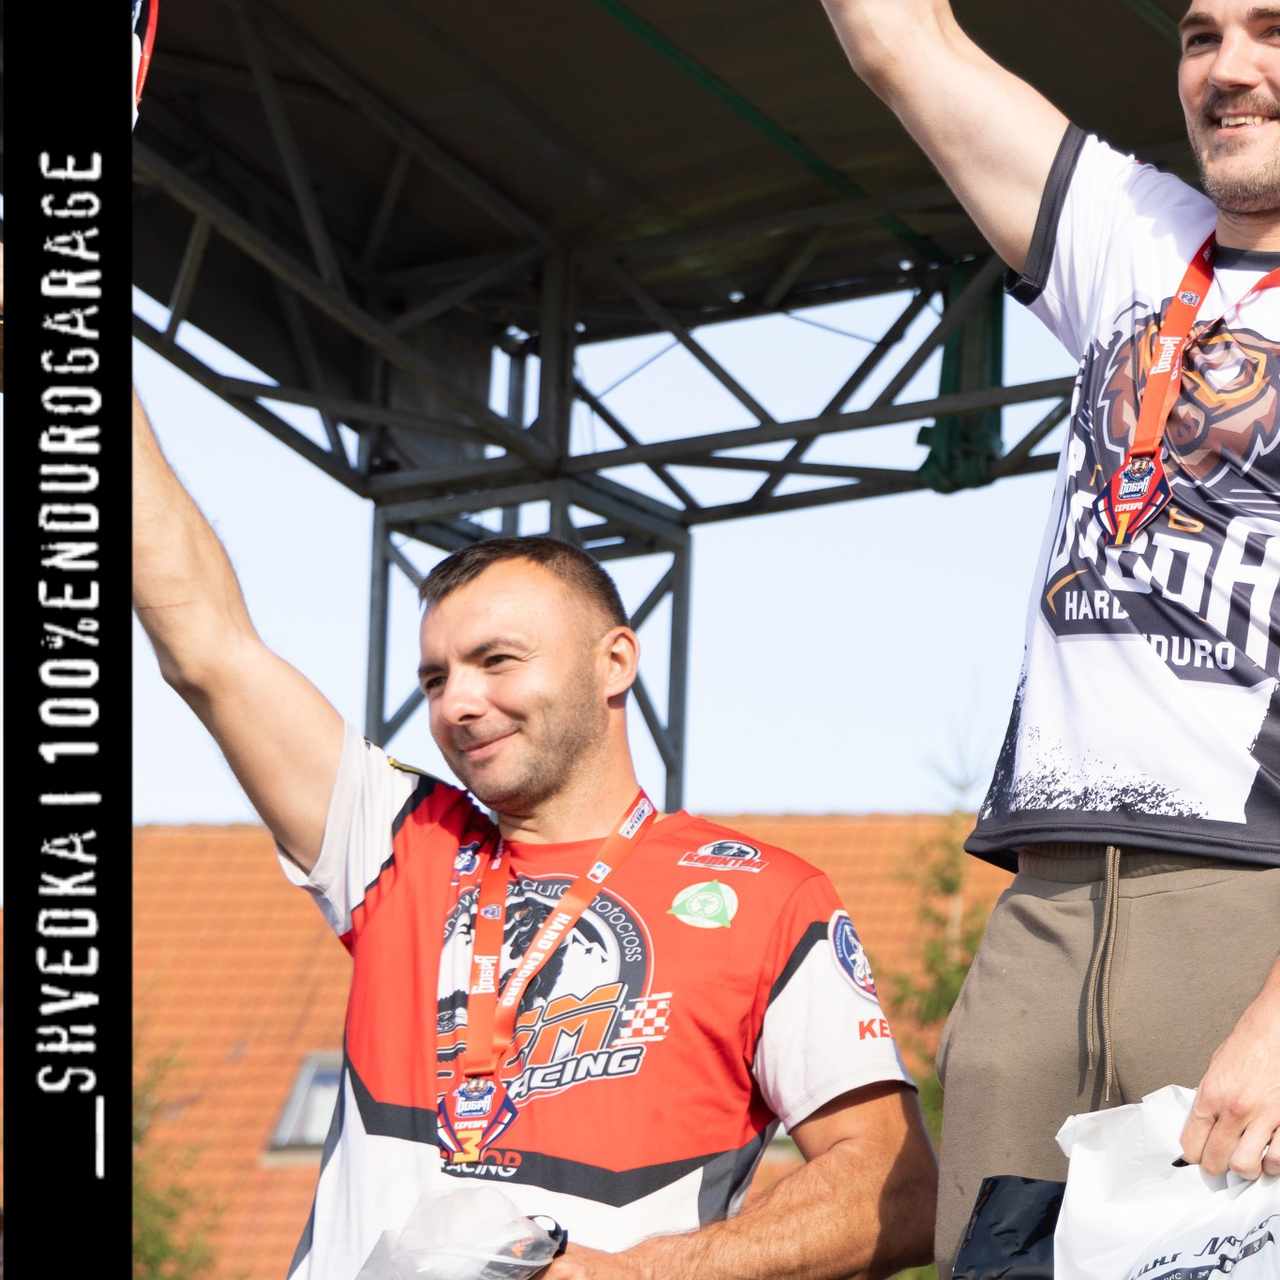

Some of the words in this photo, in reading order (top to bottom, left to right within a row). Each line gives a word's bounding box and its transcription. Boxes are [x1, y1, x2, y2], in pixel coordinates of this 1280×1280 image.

[1114, 502, 1144, 512] СЕРЕБРО
[1114, 512, 1131, 545] 1
[536, 913, 573, 948] HARD
[502, 951, 546, 1007] ENDURO
[500, 1046, 645, 1103] ACING
[452, 1130, 484, 1163] 3
